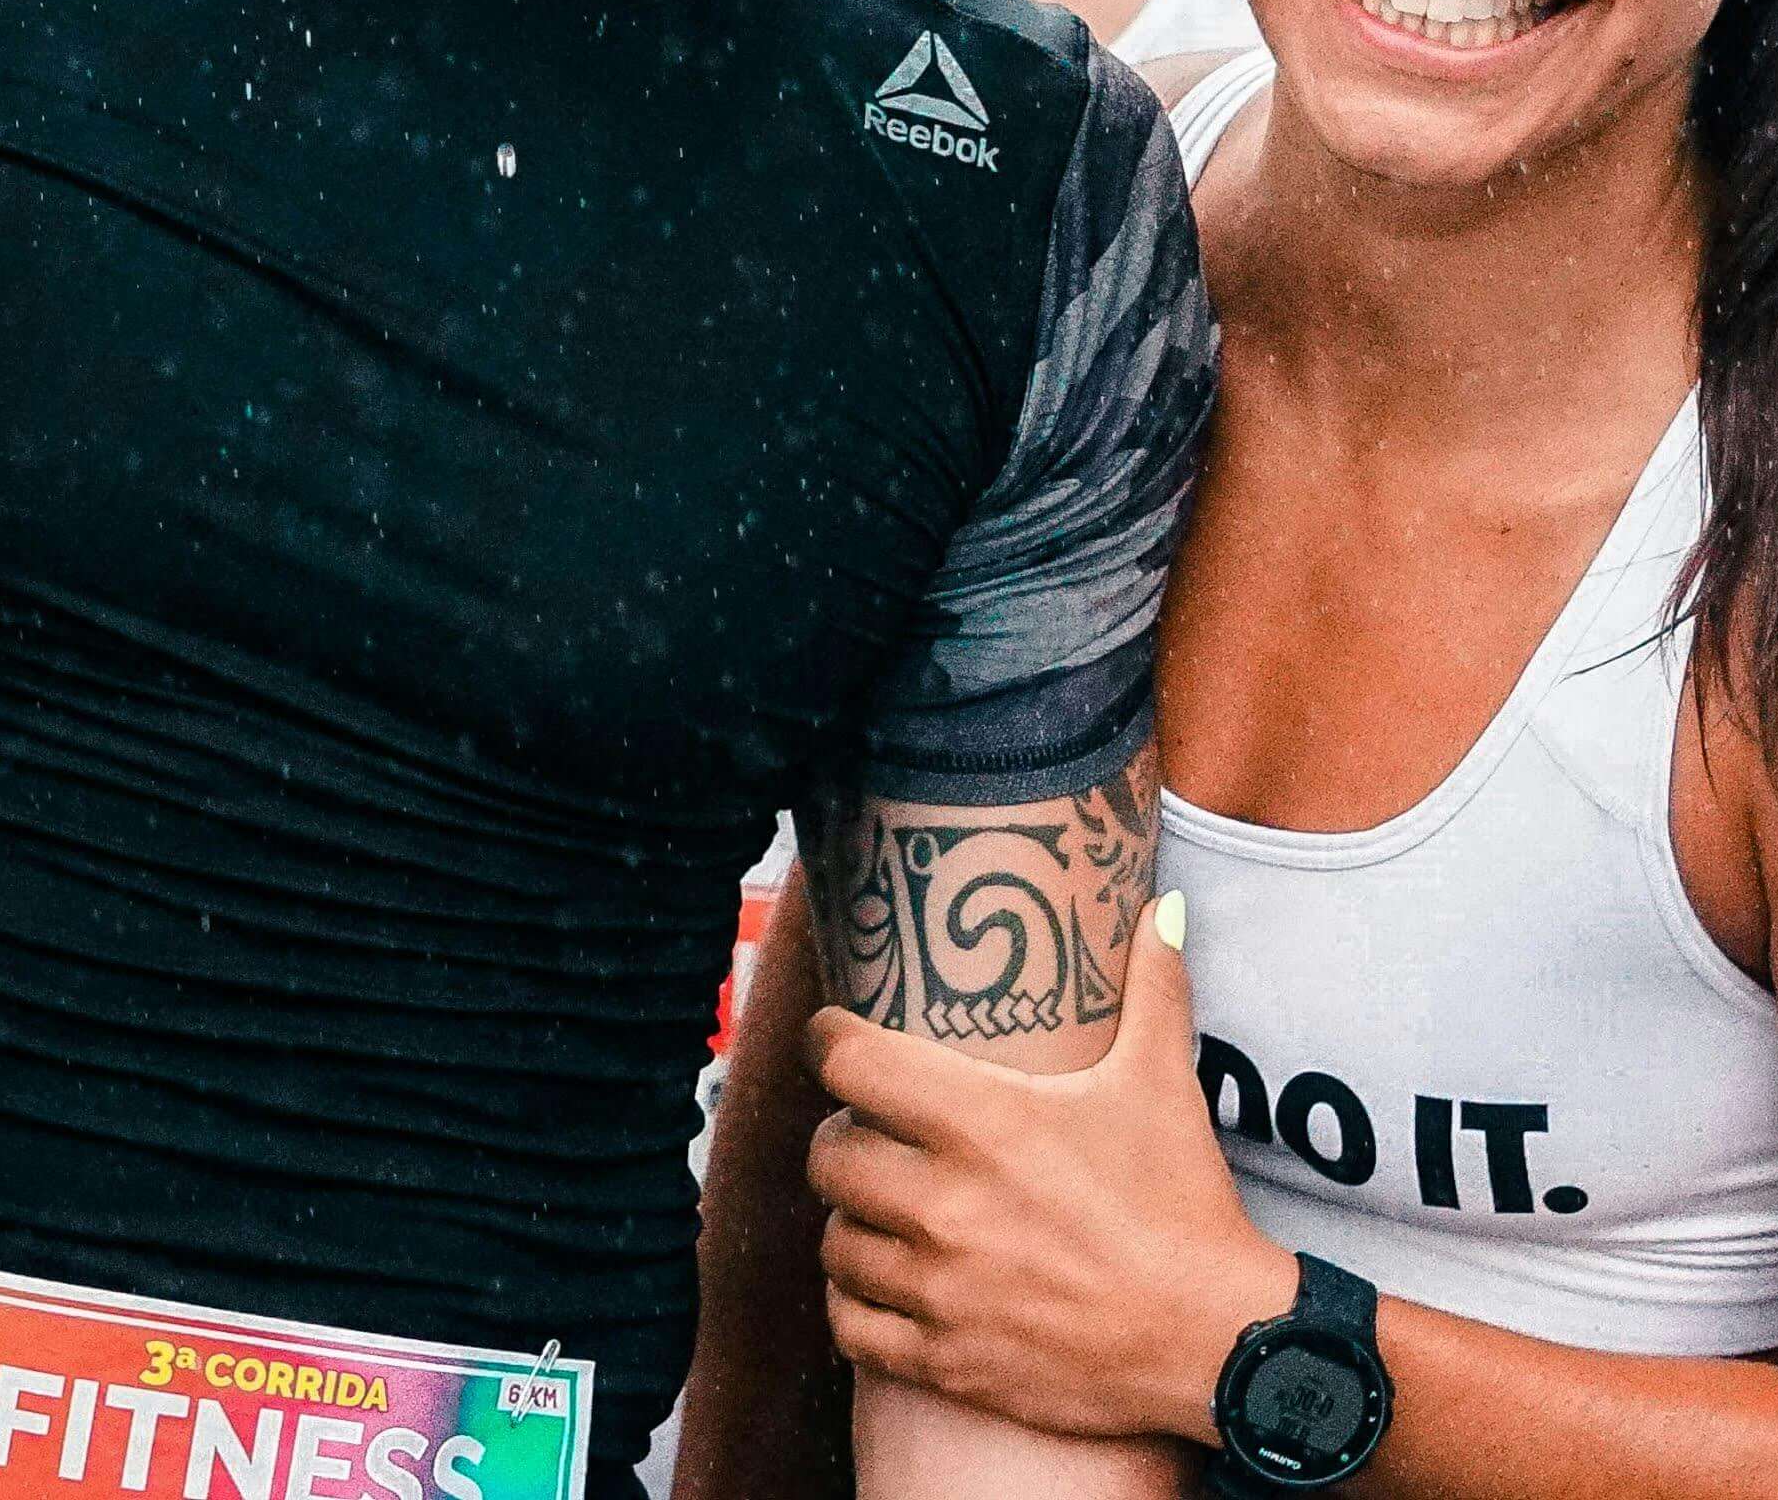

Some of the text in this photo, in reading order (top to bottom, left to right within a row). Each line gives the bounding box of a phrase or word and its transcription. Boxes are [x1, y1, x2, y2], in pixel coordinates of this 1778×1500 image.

[864, 102, 1000, 173] Reebok
[1415, 1094, 1588, 1214] IT.
[205, 1353, 389, 1412] CORRIDA
[509, 1384, 557, 1408] 6 KM
